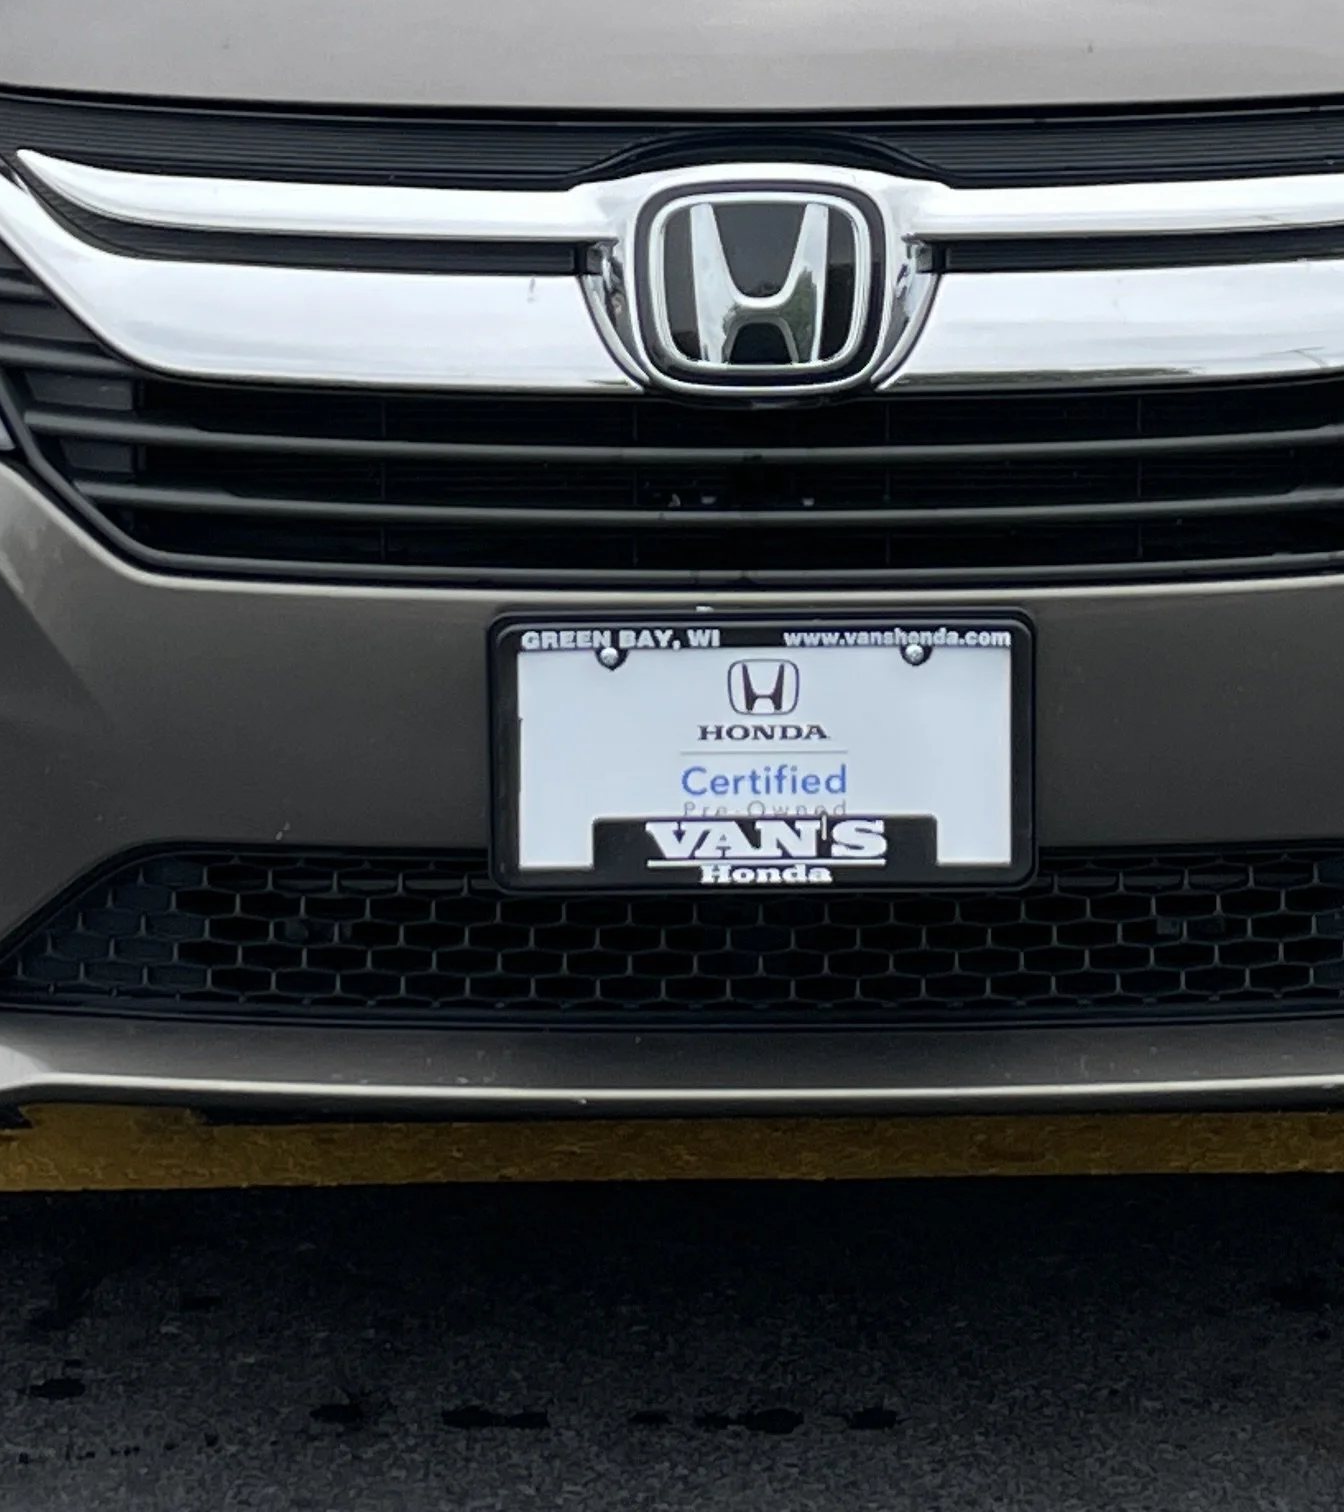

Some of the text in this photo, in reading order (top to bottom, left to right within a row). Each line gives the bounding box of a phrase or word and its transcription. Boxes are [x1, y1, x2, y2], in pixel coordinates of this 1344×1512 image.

[521, 628, 721, 651] GREEN BAY, WI
[783, 626, 1012, 647] www.vanshonda.com
[697, 724, 829, 741] HONDA
[680, 763, 847, 796] Certified
[645, 815, 888, 859] VAN'S
[700, 863, 833, 884] Honda
